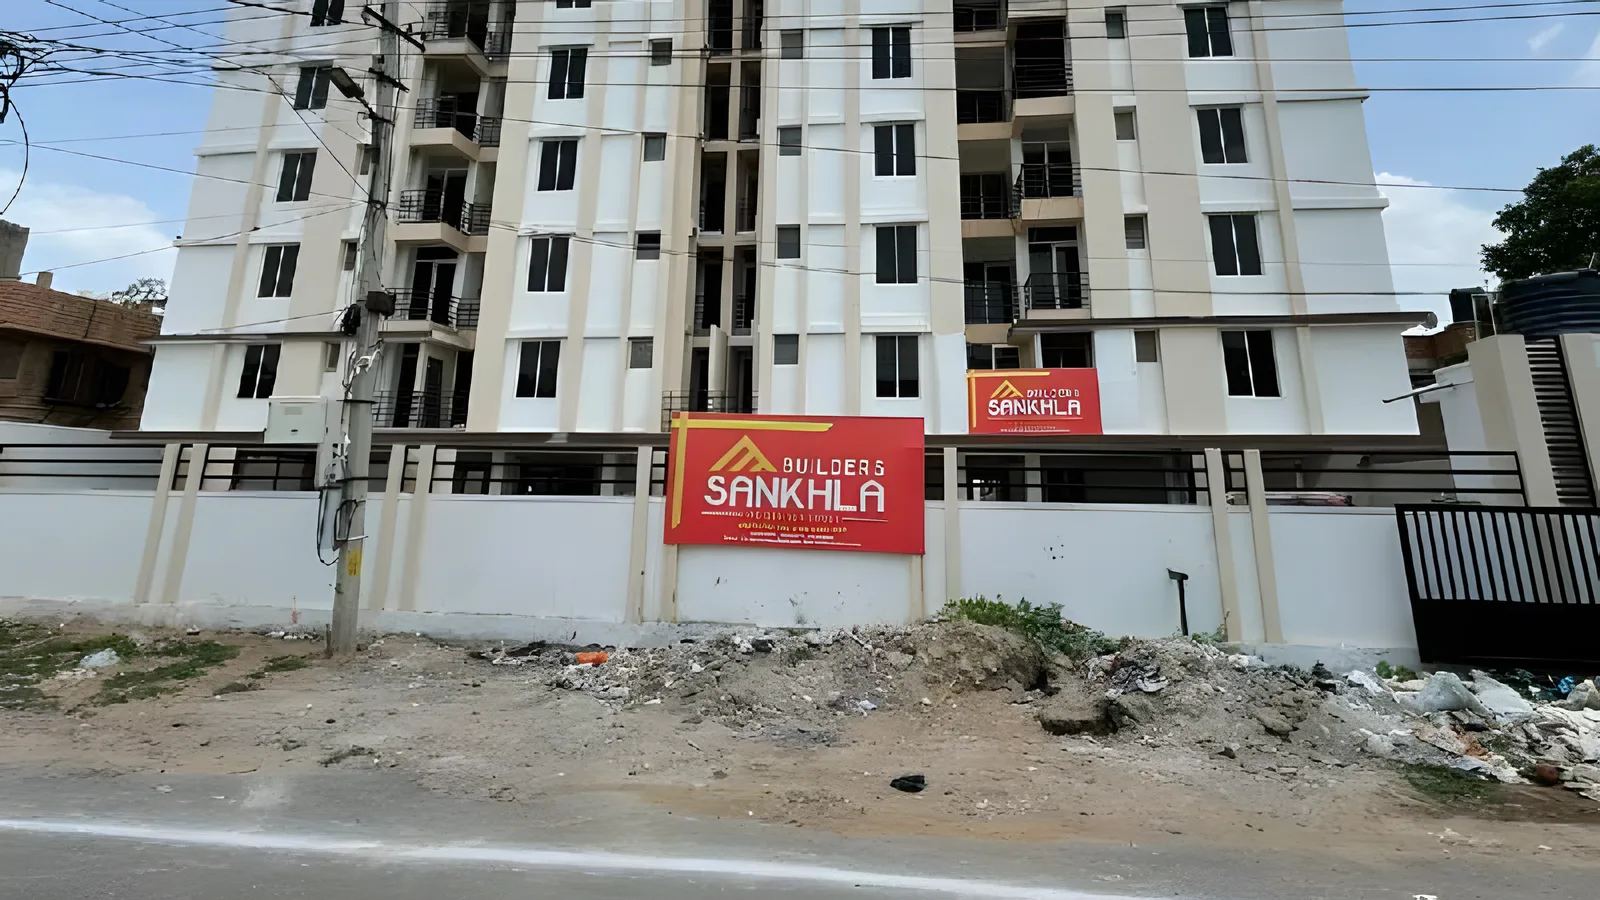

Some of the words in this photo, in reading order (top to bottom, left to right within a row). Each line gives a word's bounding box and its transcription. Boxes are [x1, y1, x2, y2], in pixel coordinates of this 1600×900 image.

[988, 399, 1080, 415] SANKHLA
[783, 457, 884, 475] BUILDERS
[704, 475, 885, 512] SANKHLA
